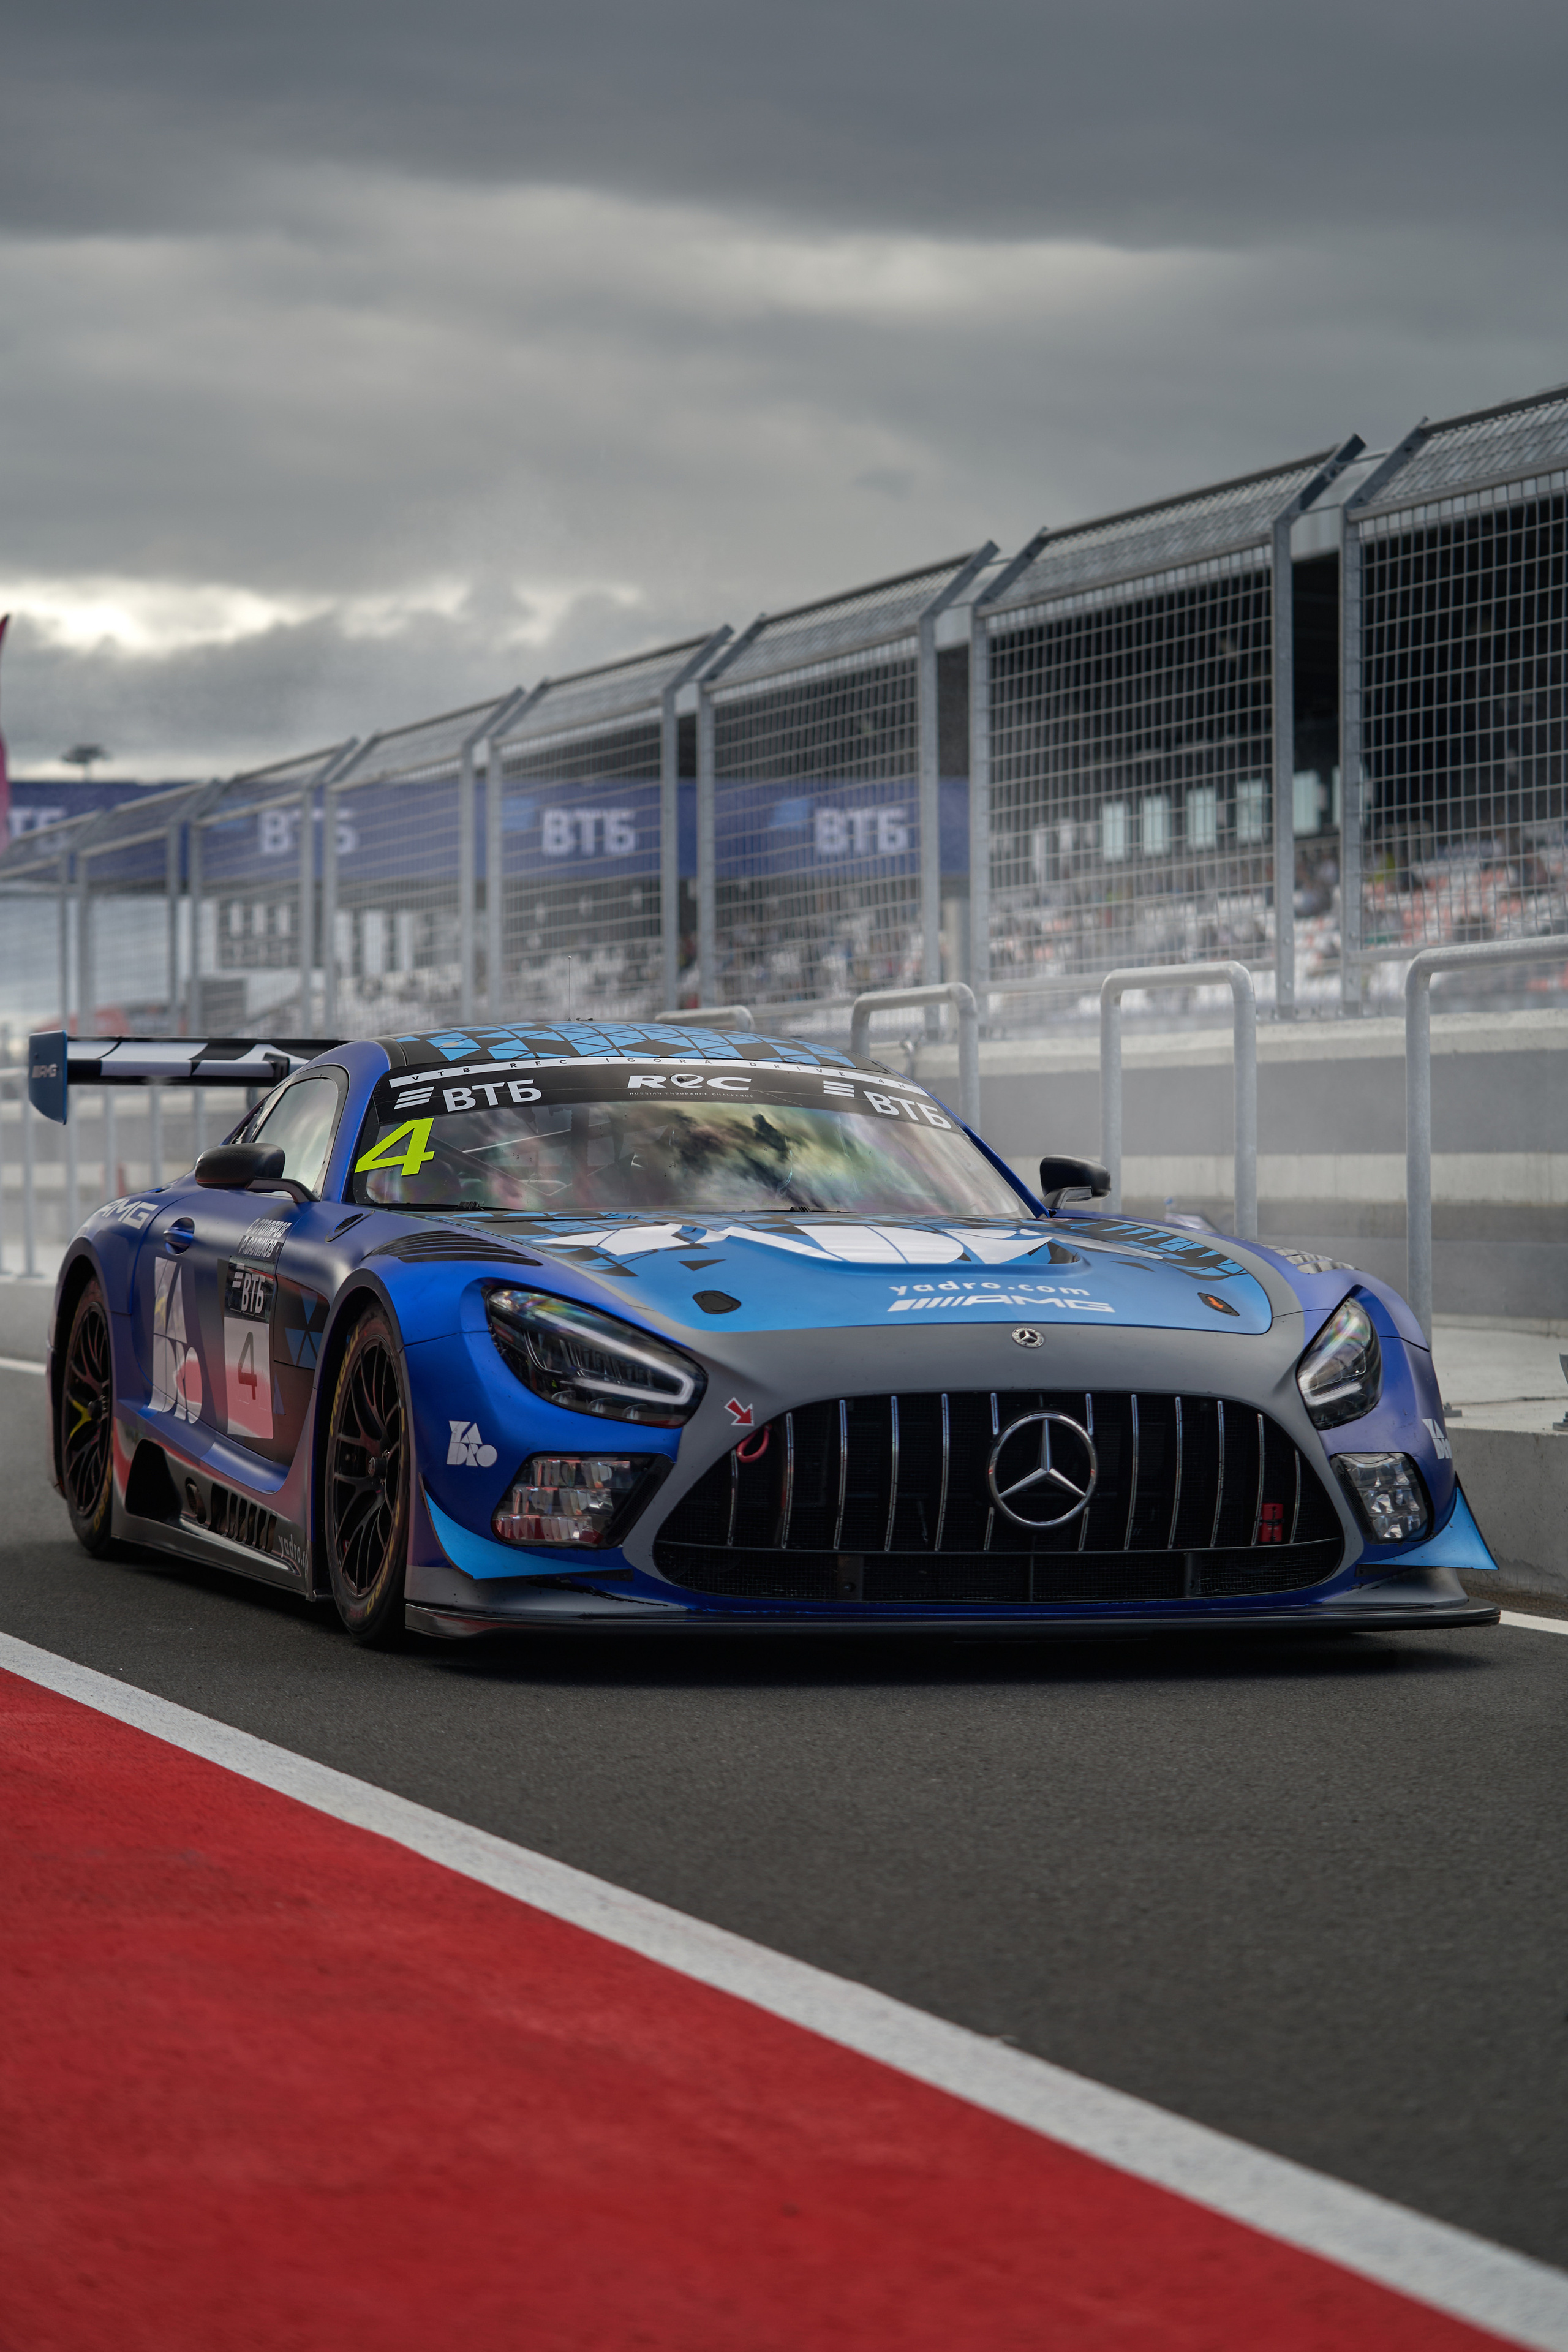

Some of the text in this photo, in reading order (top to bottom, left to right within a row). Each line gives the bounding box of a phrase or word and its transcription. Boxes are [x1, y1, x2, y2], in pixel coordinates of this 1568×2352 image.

[6, 806, 68, 853] ТБ
[541, 807, 637, 856] ВТБ
[813, 807, 910, 854] ВТБ
[412, 1068, 470, 1081] VTB
[749, 1062, 845, 1076] DRIVE
[879, 1079, 906, 1089] 4H
[442, 1079, 542, 1112] ВТБ
[863, 1091, 951, 1129] ВТБ
[355, 1118, 435, 1176] 4
[93, 1199, 159, 1229] AMG
[241, 1272, 265, 1314] ВТБ
[889, 1281, 1091, 1296] yadro.com
[961, 1294, 1115, 1313] AMG
[238, 1331, 257, 1400] 4
